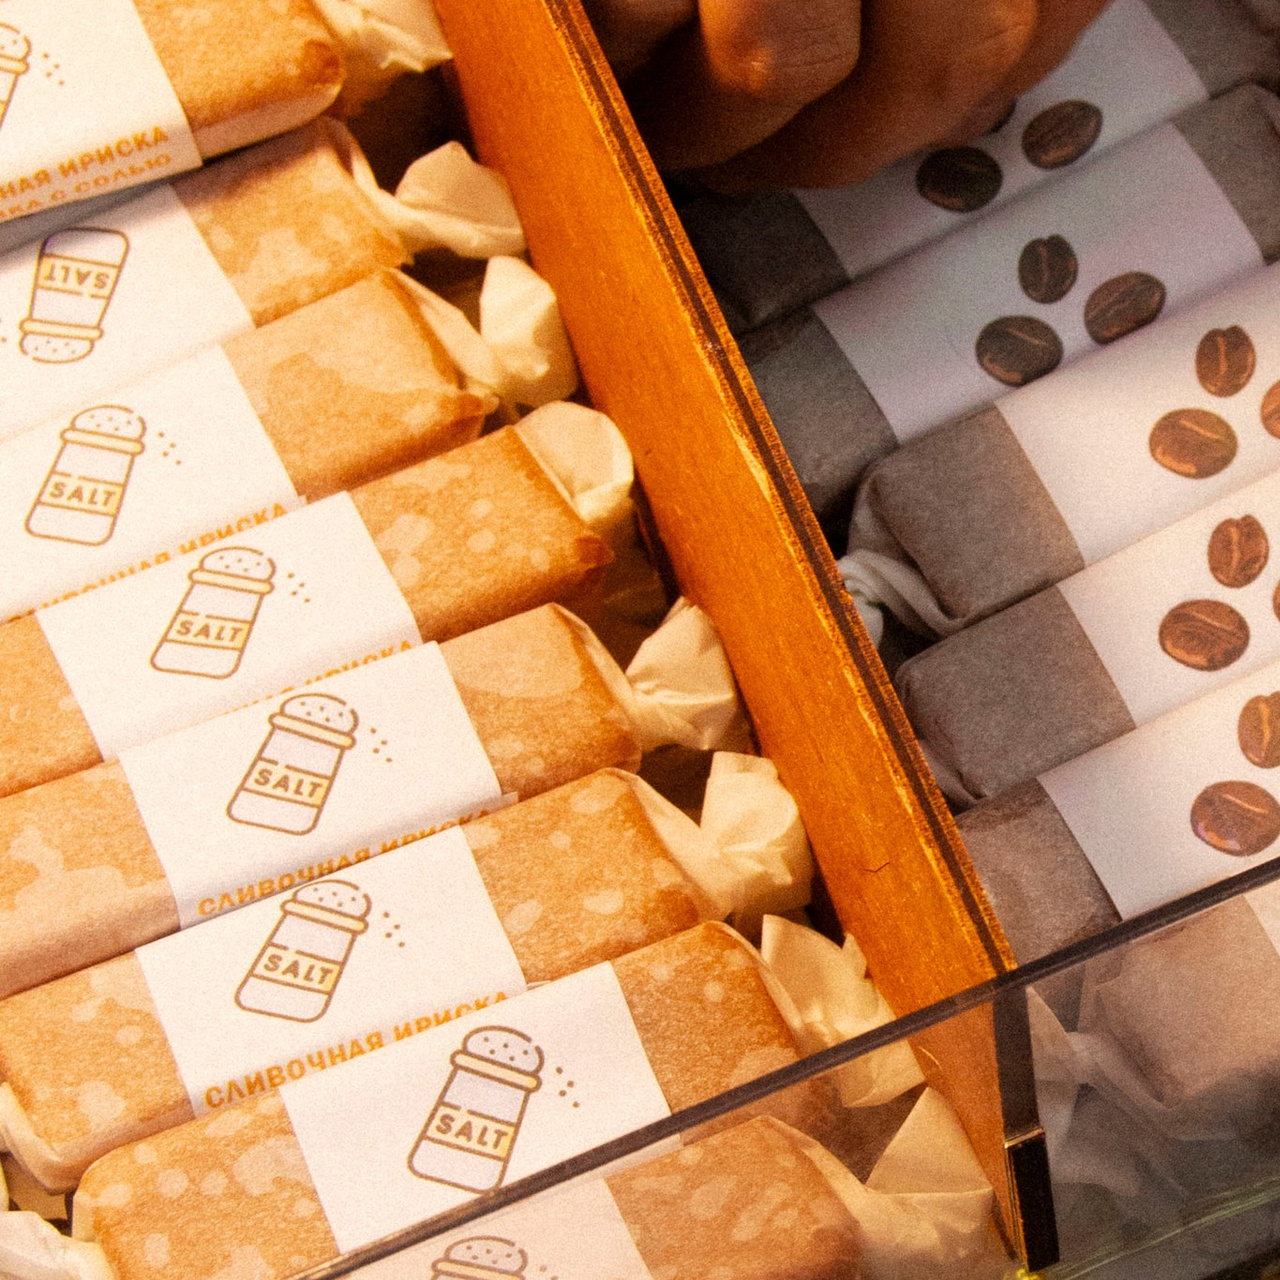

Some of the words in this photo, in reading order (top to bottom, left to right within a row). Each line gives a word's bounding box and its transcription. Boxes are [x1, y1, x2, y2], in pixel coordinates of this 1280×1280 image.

[57, 126, 170, 179] ИРИСКА
[73, 152, 172, 194] СОЛЬЮ
[43, 263, 110, 290] SALT
[49, 481, 116, 507] SALT
[176, 620, 243, 643] SALT
[254, 768, 323, 799] SALT
[263, 953, 334, 985] SALT
[204, 1030, 384, 1109] СЛИВОЧНАЯ
[436, 1113, 508, 1150] SALT
